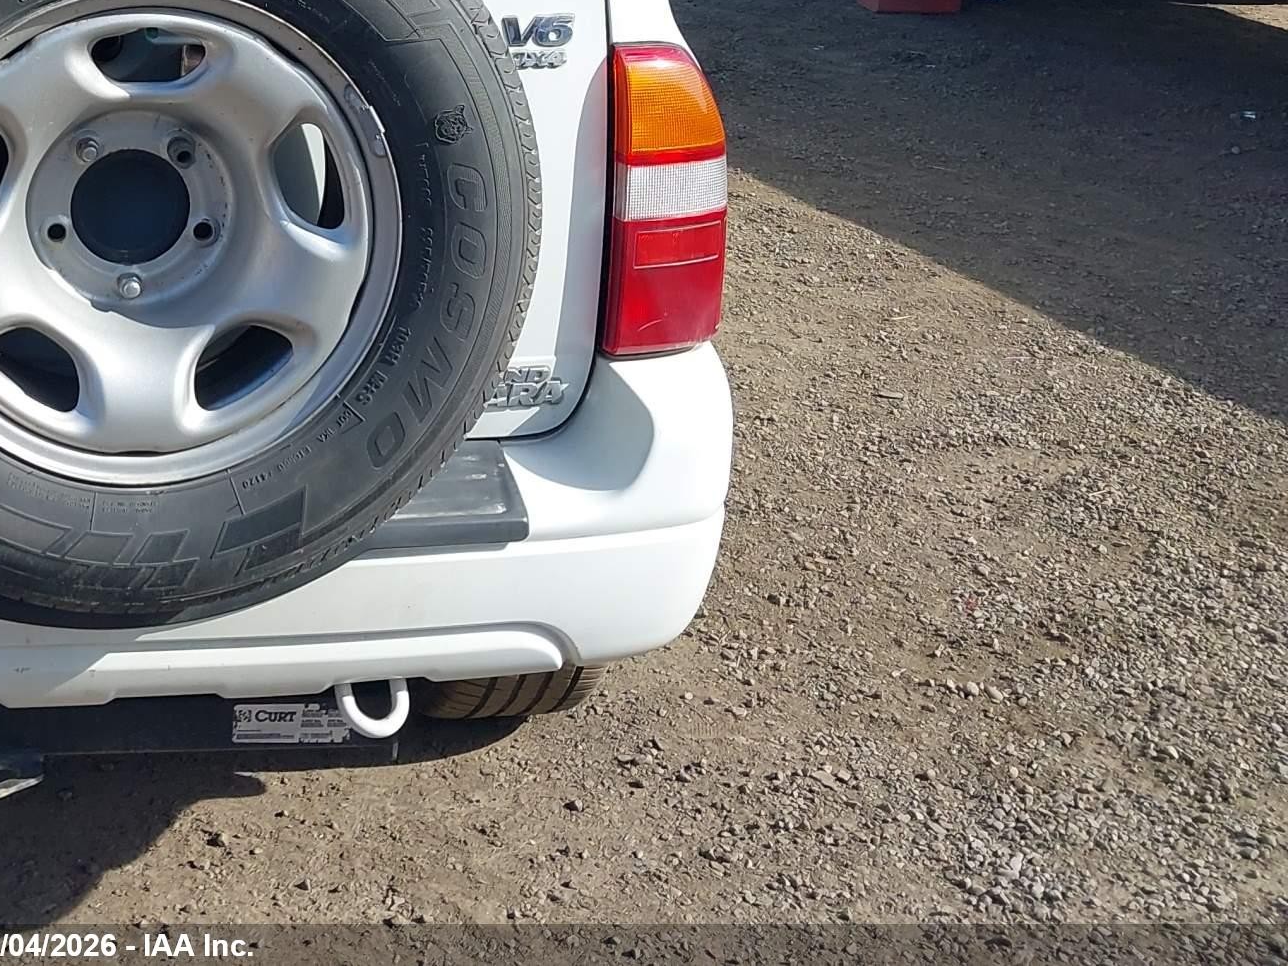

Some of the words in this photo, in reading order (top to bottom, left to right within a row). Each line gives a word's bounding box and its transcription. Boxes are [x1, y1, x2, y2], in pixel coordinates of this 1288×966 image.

[502, 15, 574, 47] V6
[366, 163, 488, 471] COSMO
[254, 710, 297, 723] CURT
